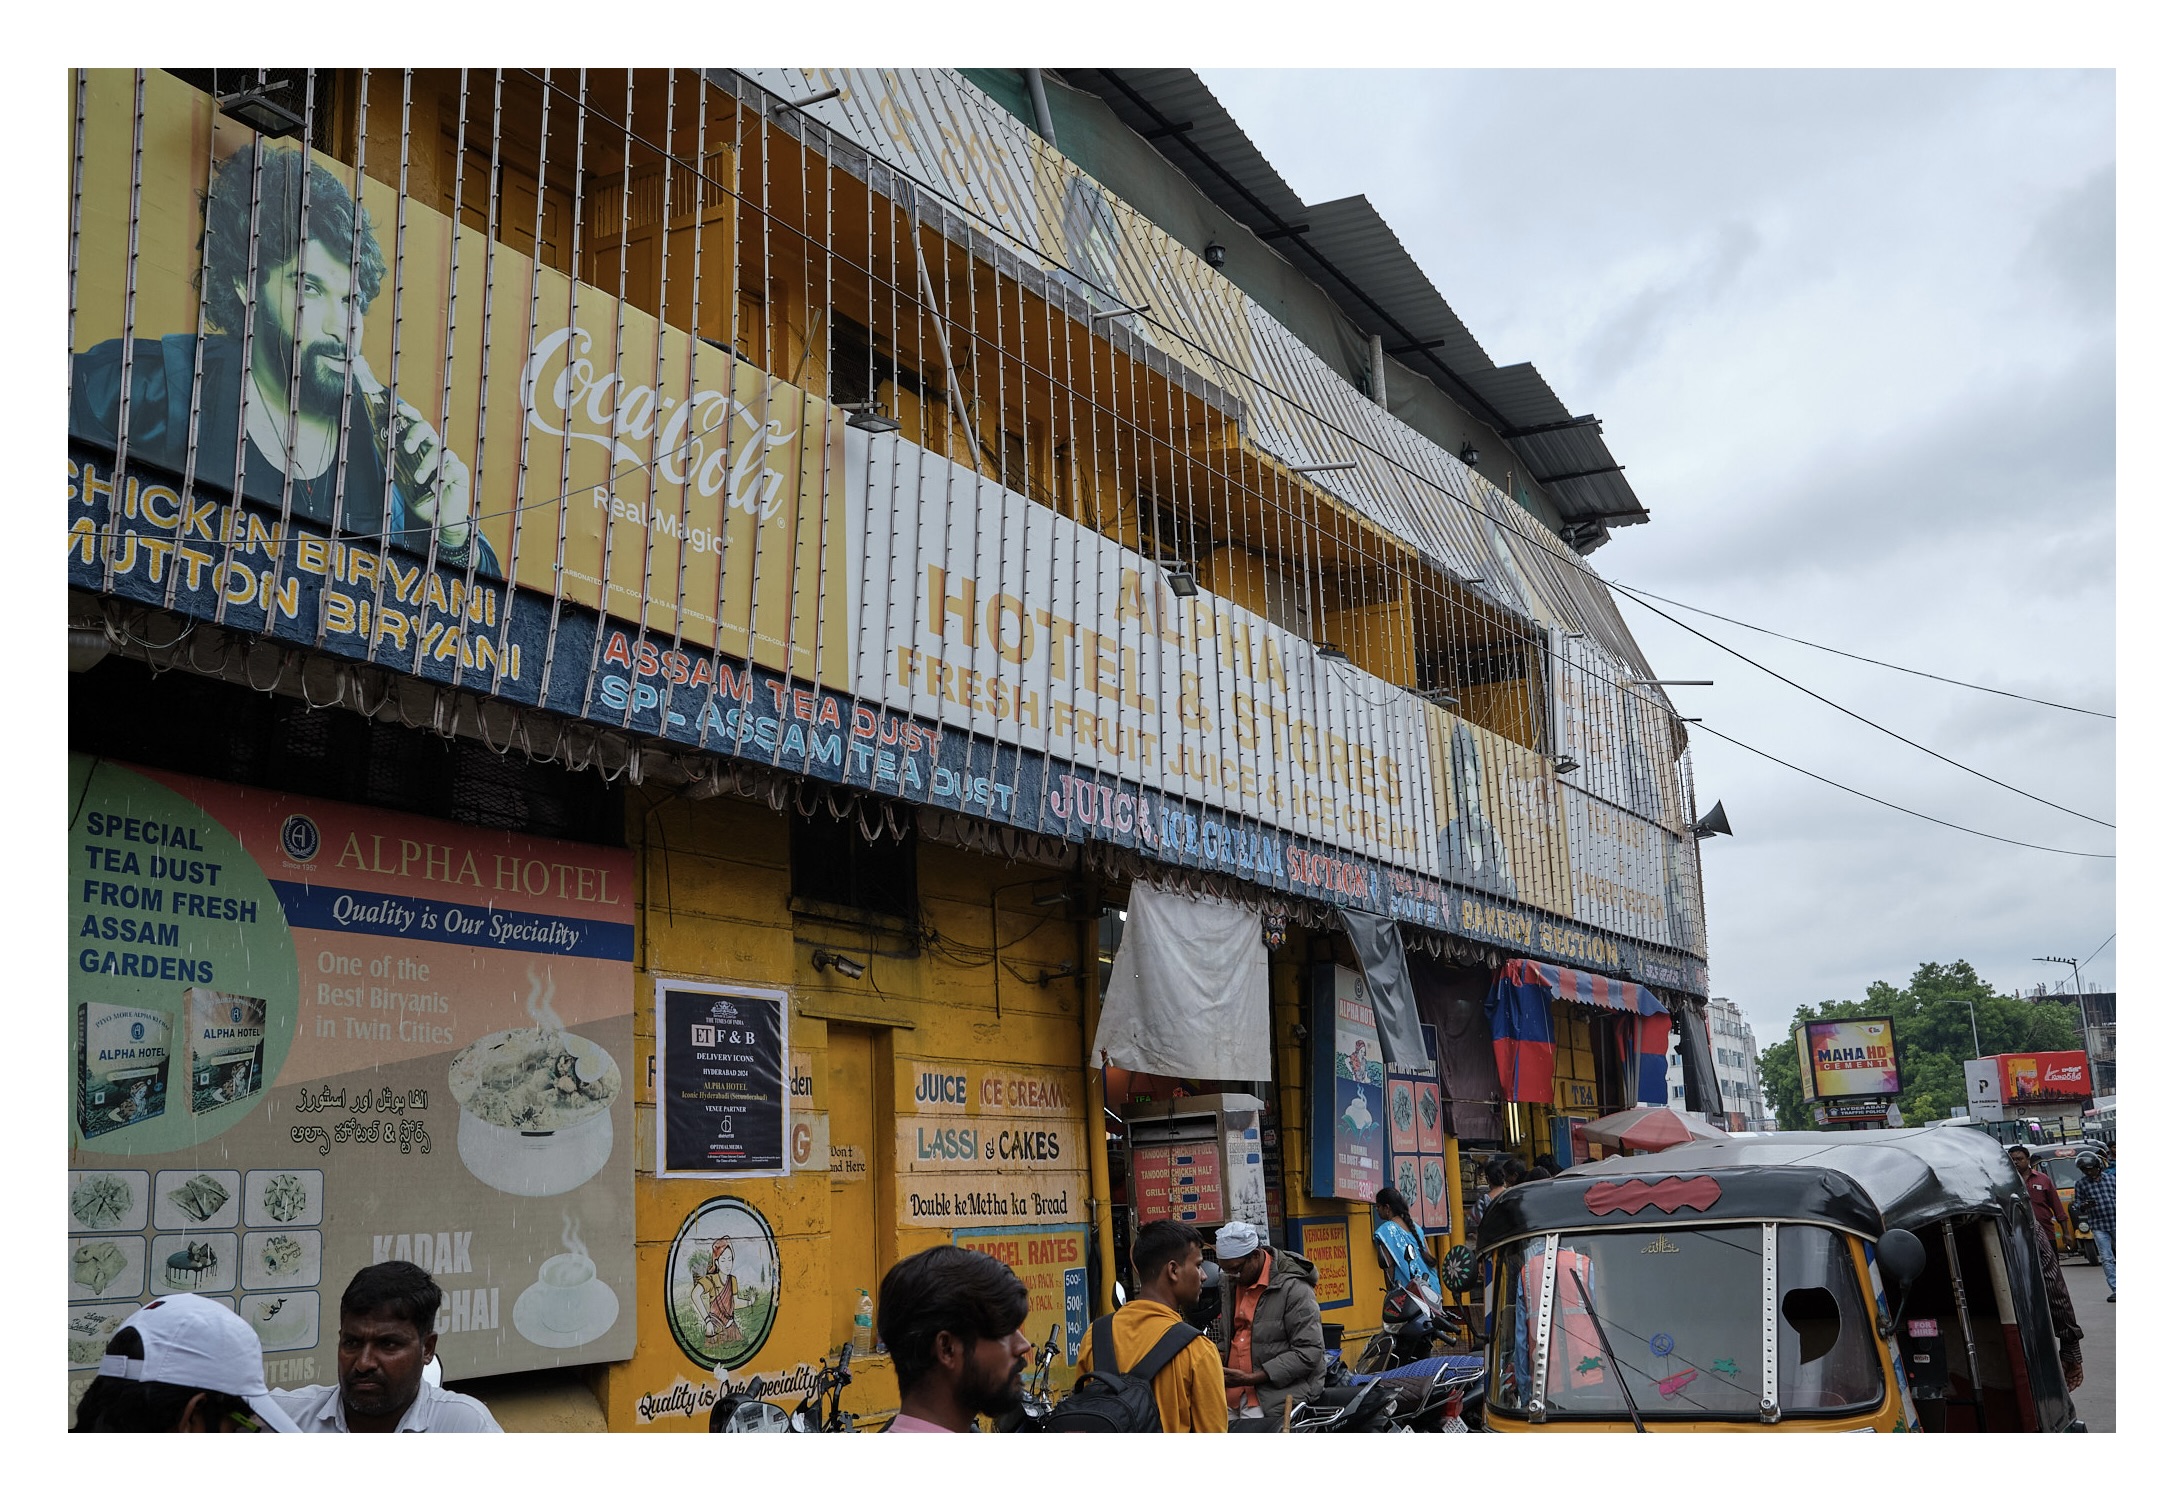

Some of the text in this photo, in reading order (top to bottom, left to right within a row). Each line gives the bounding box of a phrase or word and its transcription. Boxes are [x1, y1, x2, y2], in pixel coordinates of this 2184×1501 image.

[520, 326, 797, 521] Coca-Cola
[593, 484, 726, 557] Real Magic
[297, 529, 497, 627] BIRYANI
[320, 588, 521, 681] BIRYANI
[1114, 566, 1287, 693] ALPHA
[603, 630, 944, 757] ASSAM TEA DUST
[926, 564, 1404, 807] HOTEL & STORES
[601, 674, 1014, 812] SPL ASSAM TEA DUST
[898, 645, 1419, 853] FRESH FRUIT JUICE & ICE CREAM
[86, 810, 203, 852] SPECIAL
[282, 860, 301, 870] Since
[1159, 805, 1199, 857] ICE
[1202, 820, 1284, 877] CREAM
[1286, 844, 1369, 899] SECTION
[84, 845, 222, 888] TEA DUST
[335, 831, 621, 906] ALPHA HOTEL
[83, 880, 257, 924] FROM FRESH
[80, 914, 180, 948] ASSAM
[332, 894, 580, 950] Quality is Our Speciality
[1539, 921, 1618, 966] SECTION
[79, 949, 214, 984] GARDENS
[317, 950, 431, 983] One of the
[317, 983, 450, 1017] Best Biryanis
[1339, 999, 1360, 1020] ALPHA
[203, 1028, 261, 1039] ALPHA HOTEL
[316, 1015, 454, 1046] in Twin Cities
[695, 1028, 755, 1045] ET F & B
[98, 1047, 166, 1061] ALPHA HOTEL
[696, 1052, 754, 1063] DELIVERY ICONS
[1817, 1044, 1887, 1062] MAHA HD
[1823, 1060, 1883, 1070] CEMENT
[703, 1068, 748, 1077] HYDERABAD 2024
[703, 1081, 748, 1091] ALPHA HOTEL
[296, 1085, 347, 1113] اسٹورز
[682, 1090, 699, 1099] Iconic
[699, 1091, 730, 1101] Hyderabadi
[915, 1072, 967, 1104] JUICE
[979, 1080, 1002, 1107] ICE
[1135, 1095, 1152, 1103] TEA
[1571, 1085, 1594, 1106] TEA
[1979, 1079, 1989, 1094] P
[350, 1089, 373, 1113] اور
[1840, 1104, 1886, 1112] HYDERABAD
[383, 1122, 396, 1143] &
[916, 1127, 1060, 1162] LASSI & CAKES
[845, 1160, 867, 1173] Here
[1141, 1149, 1170, 1160] TANDOORI
[1171, 1147, 1196, 1158] CHICKEN
[1141, 1165, 1213, 1180] TANDOORI CHICKEN HALF
[909, 1189, 1068, 1217] Double ke Metha ka Bread
[1145, 1184, 1220, 1197] GRILL CHICKEN HALF
[1147, 1202, 1215, 1214] GRILL CHICKEN FULL
[1304, 1227, 1344, 1243] VEHICLES KEPT
[372, 1231, 473, 1275] KADAK
[1027, 1238, 1078, 1265] RATES
[1306, 1245, 1346, 1261] AT OWNER RISK
[1037, 1273, 1055, 1289] PACK
[1036, 1294, 1053, 1311] PACK
[1066, 1295, 1083, 1312] 500/-
[1914, 1321, 1932, 1329] FOR
[638, 1366, 820, 1420] Quality is Our peciality
